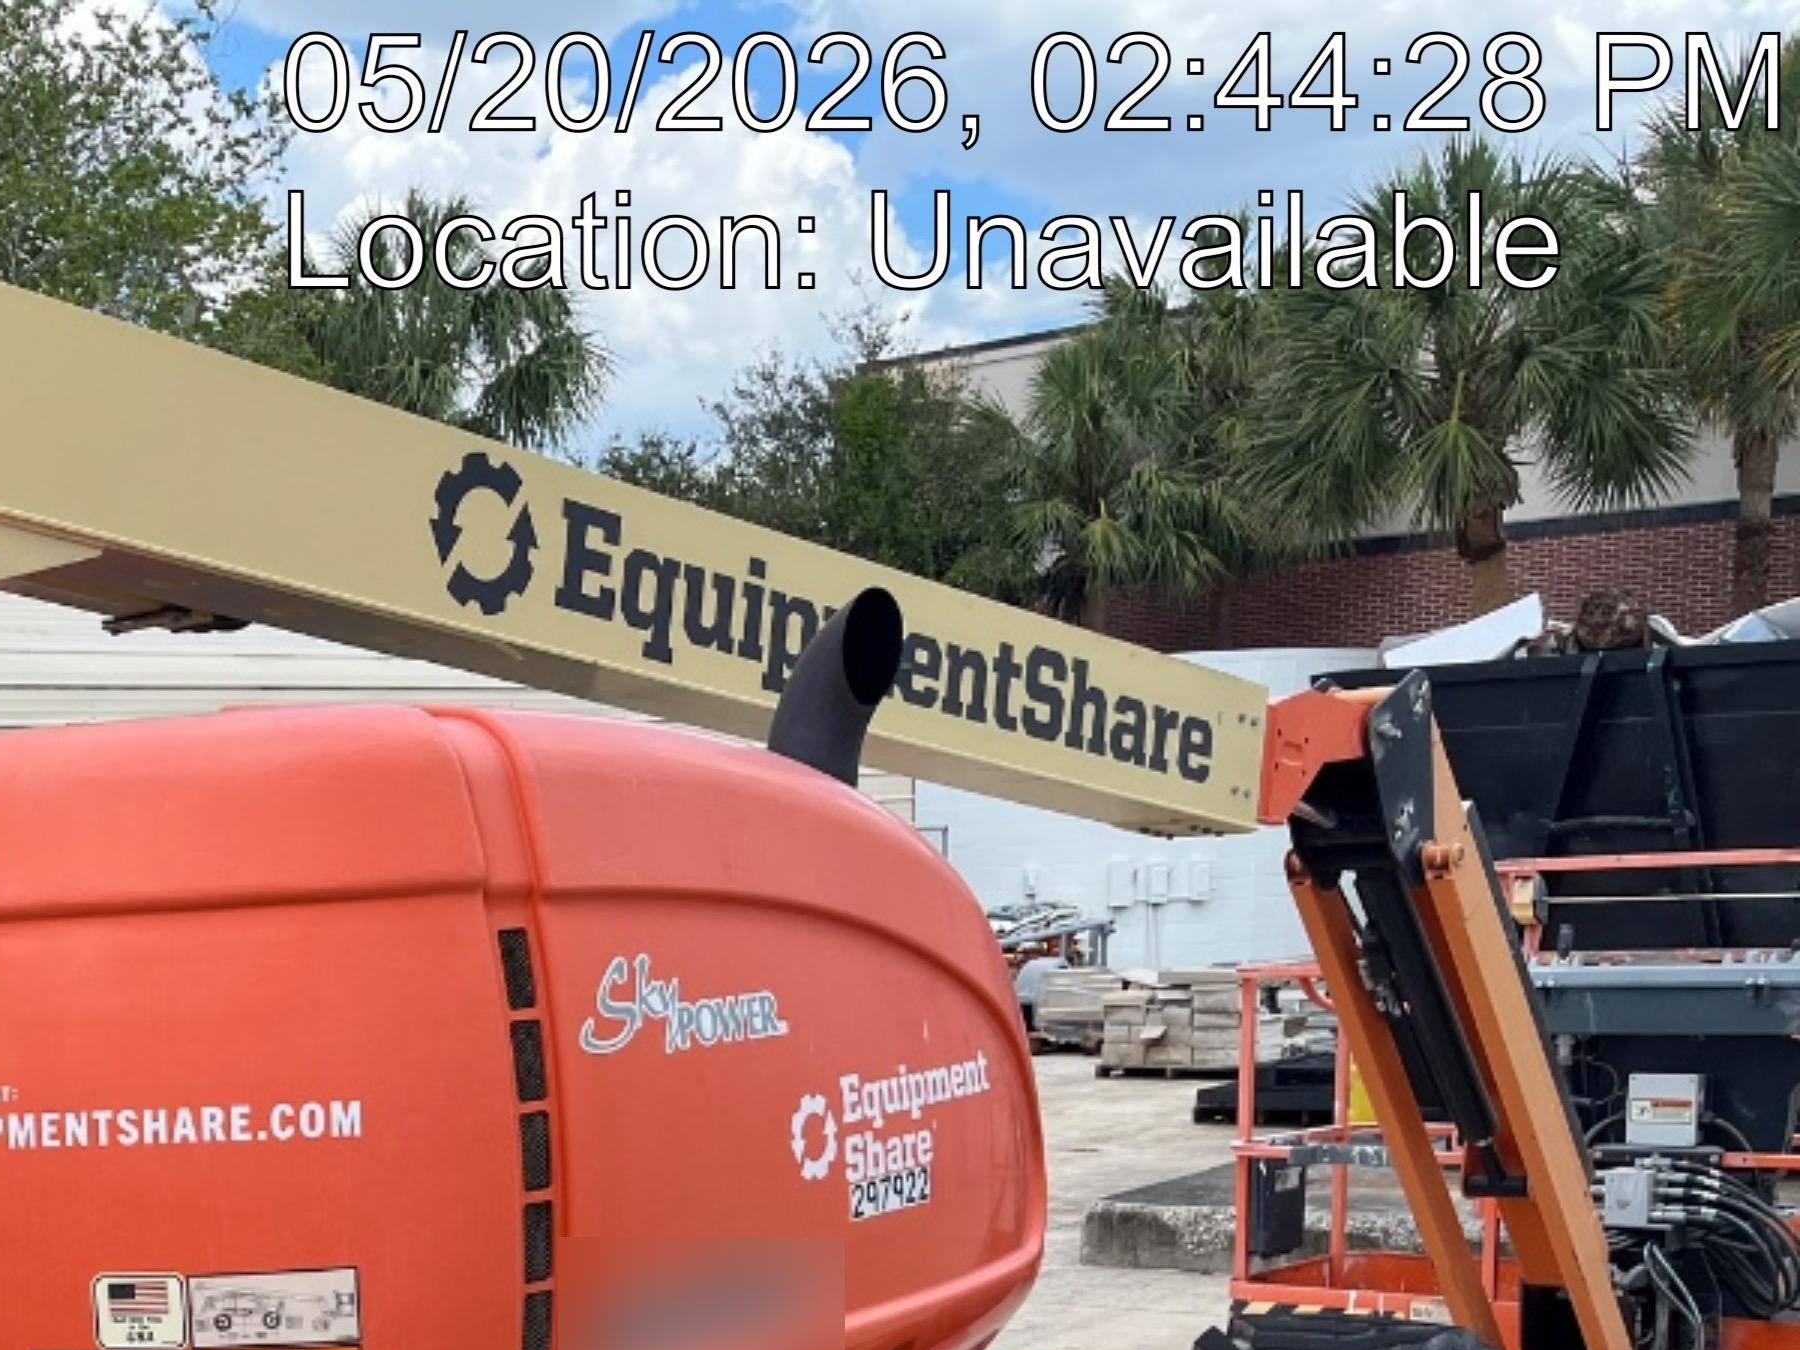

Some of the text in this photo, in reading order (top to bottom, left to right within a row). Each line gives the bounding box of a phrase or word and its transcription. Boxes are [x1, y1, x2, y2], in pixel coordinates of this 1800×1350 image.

[554, 497, 1214, 785] EquipentShare
[839, 1048, 991, 1128] Equipment
[845, 1129, 934, 1183] Share
[851, 1168, 929, 1219] 297922
